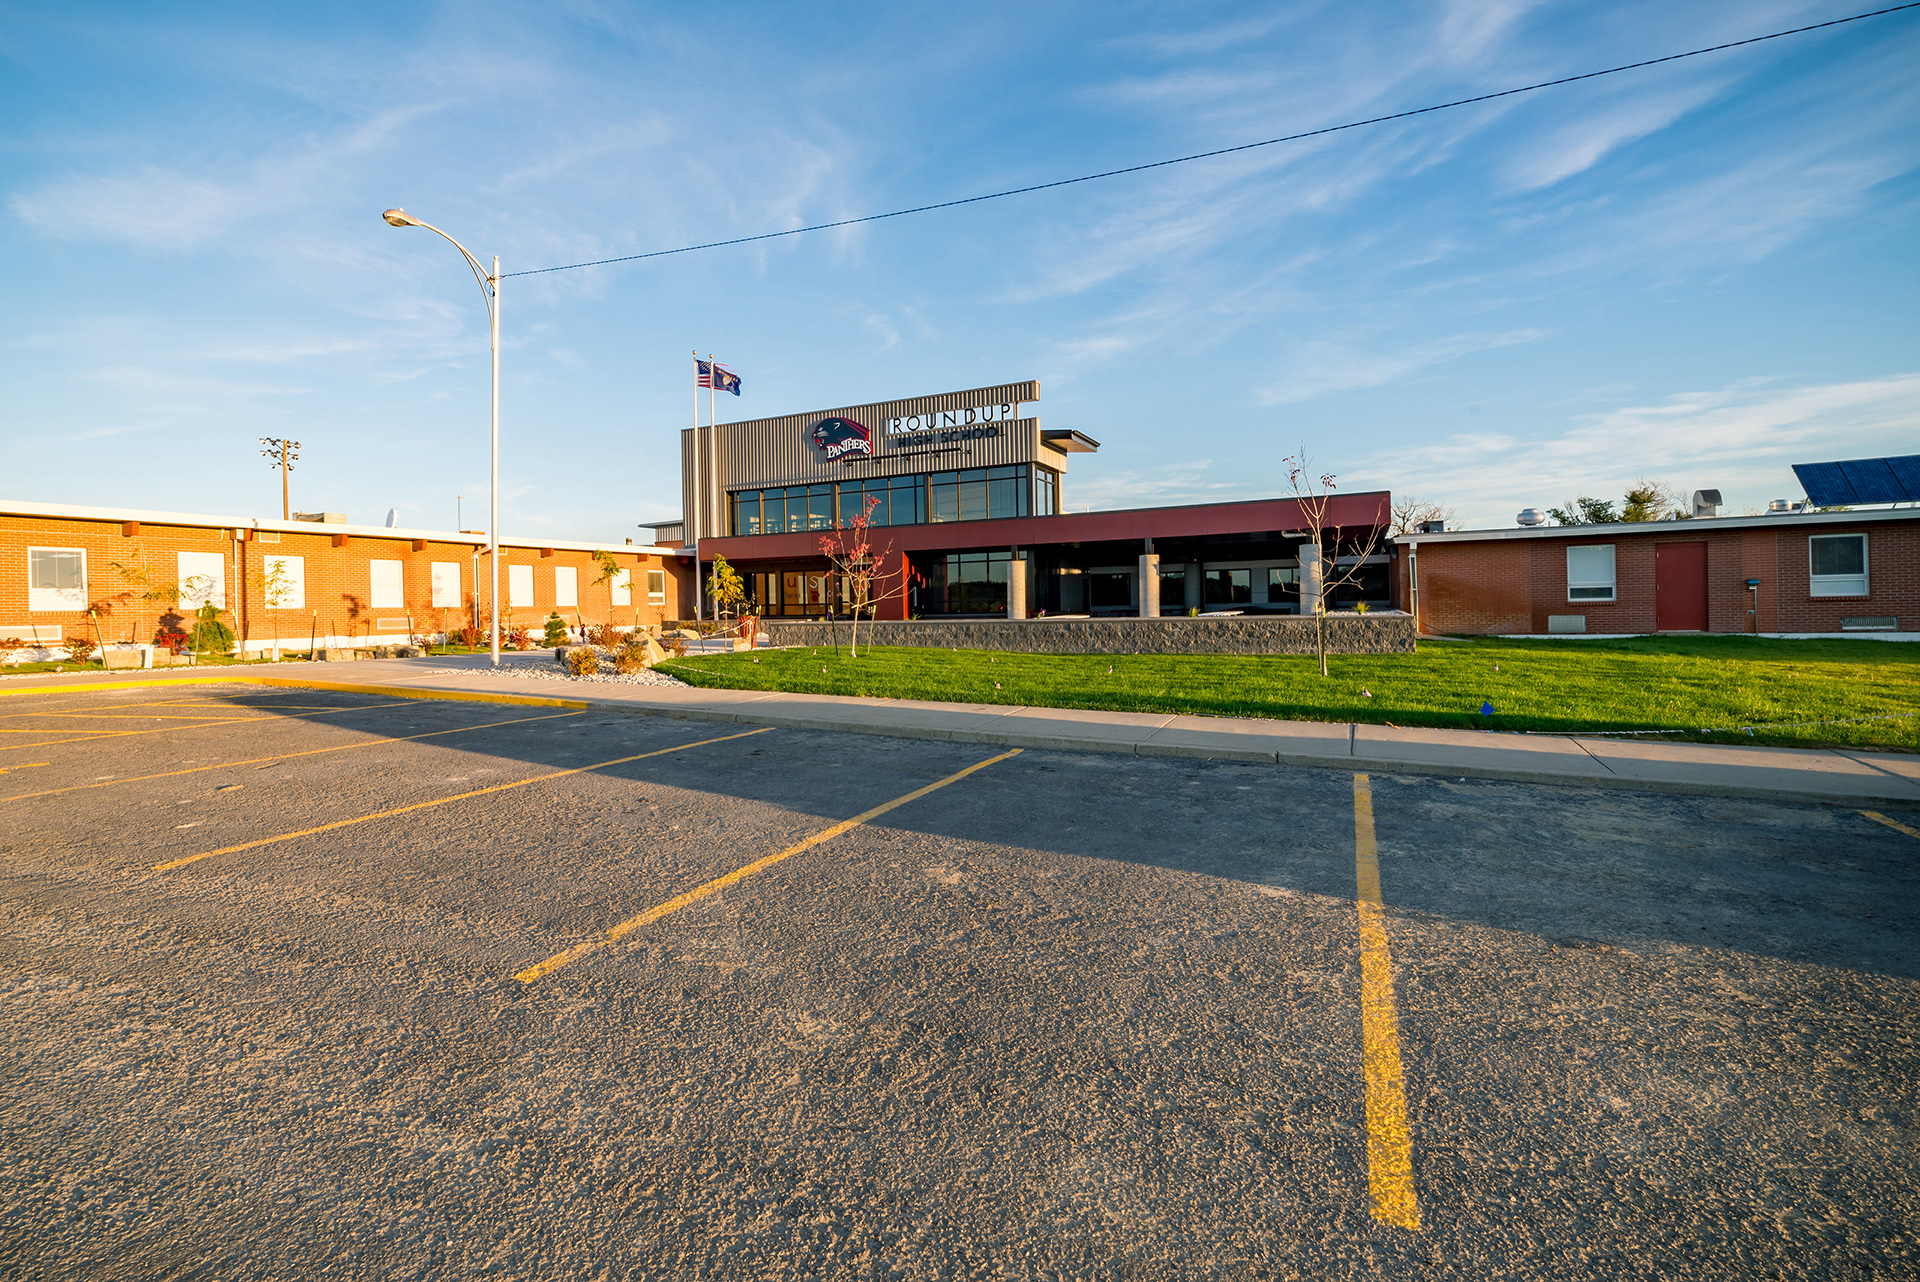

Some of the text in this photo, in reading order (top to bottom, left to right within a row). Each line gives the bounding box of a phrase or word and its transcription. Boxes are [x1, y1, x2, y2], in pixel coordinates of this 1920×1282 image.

[893, 403, 1011, 434] ROUNDUP
[826, 437, 871, 459] PANTHERS
[898, 425, 1005, 448] HIGH SCHOOL
